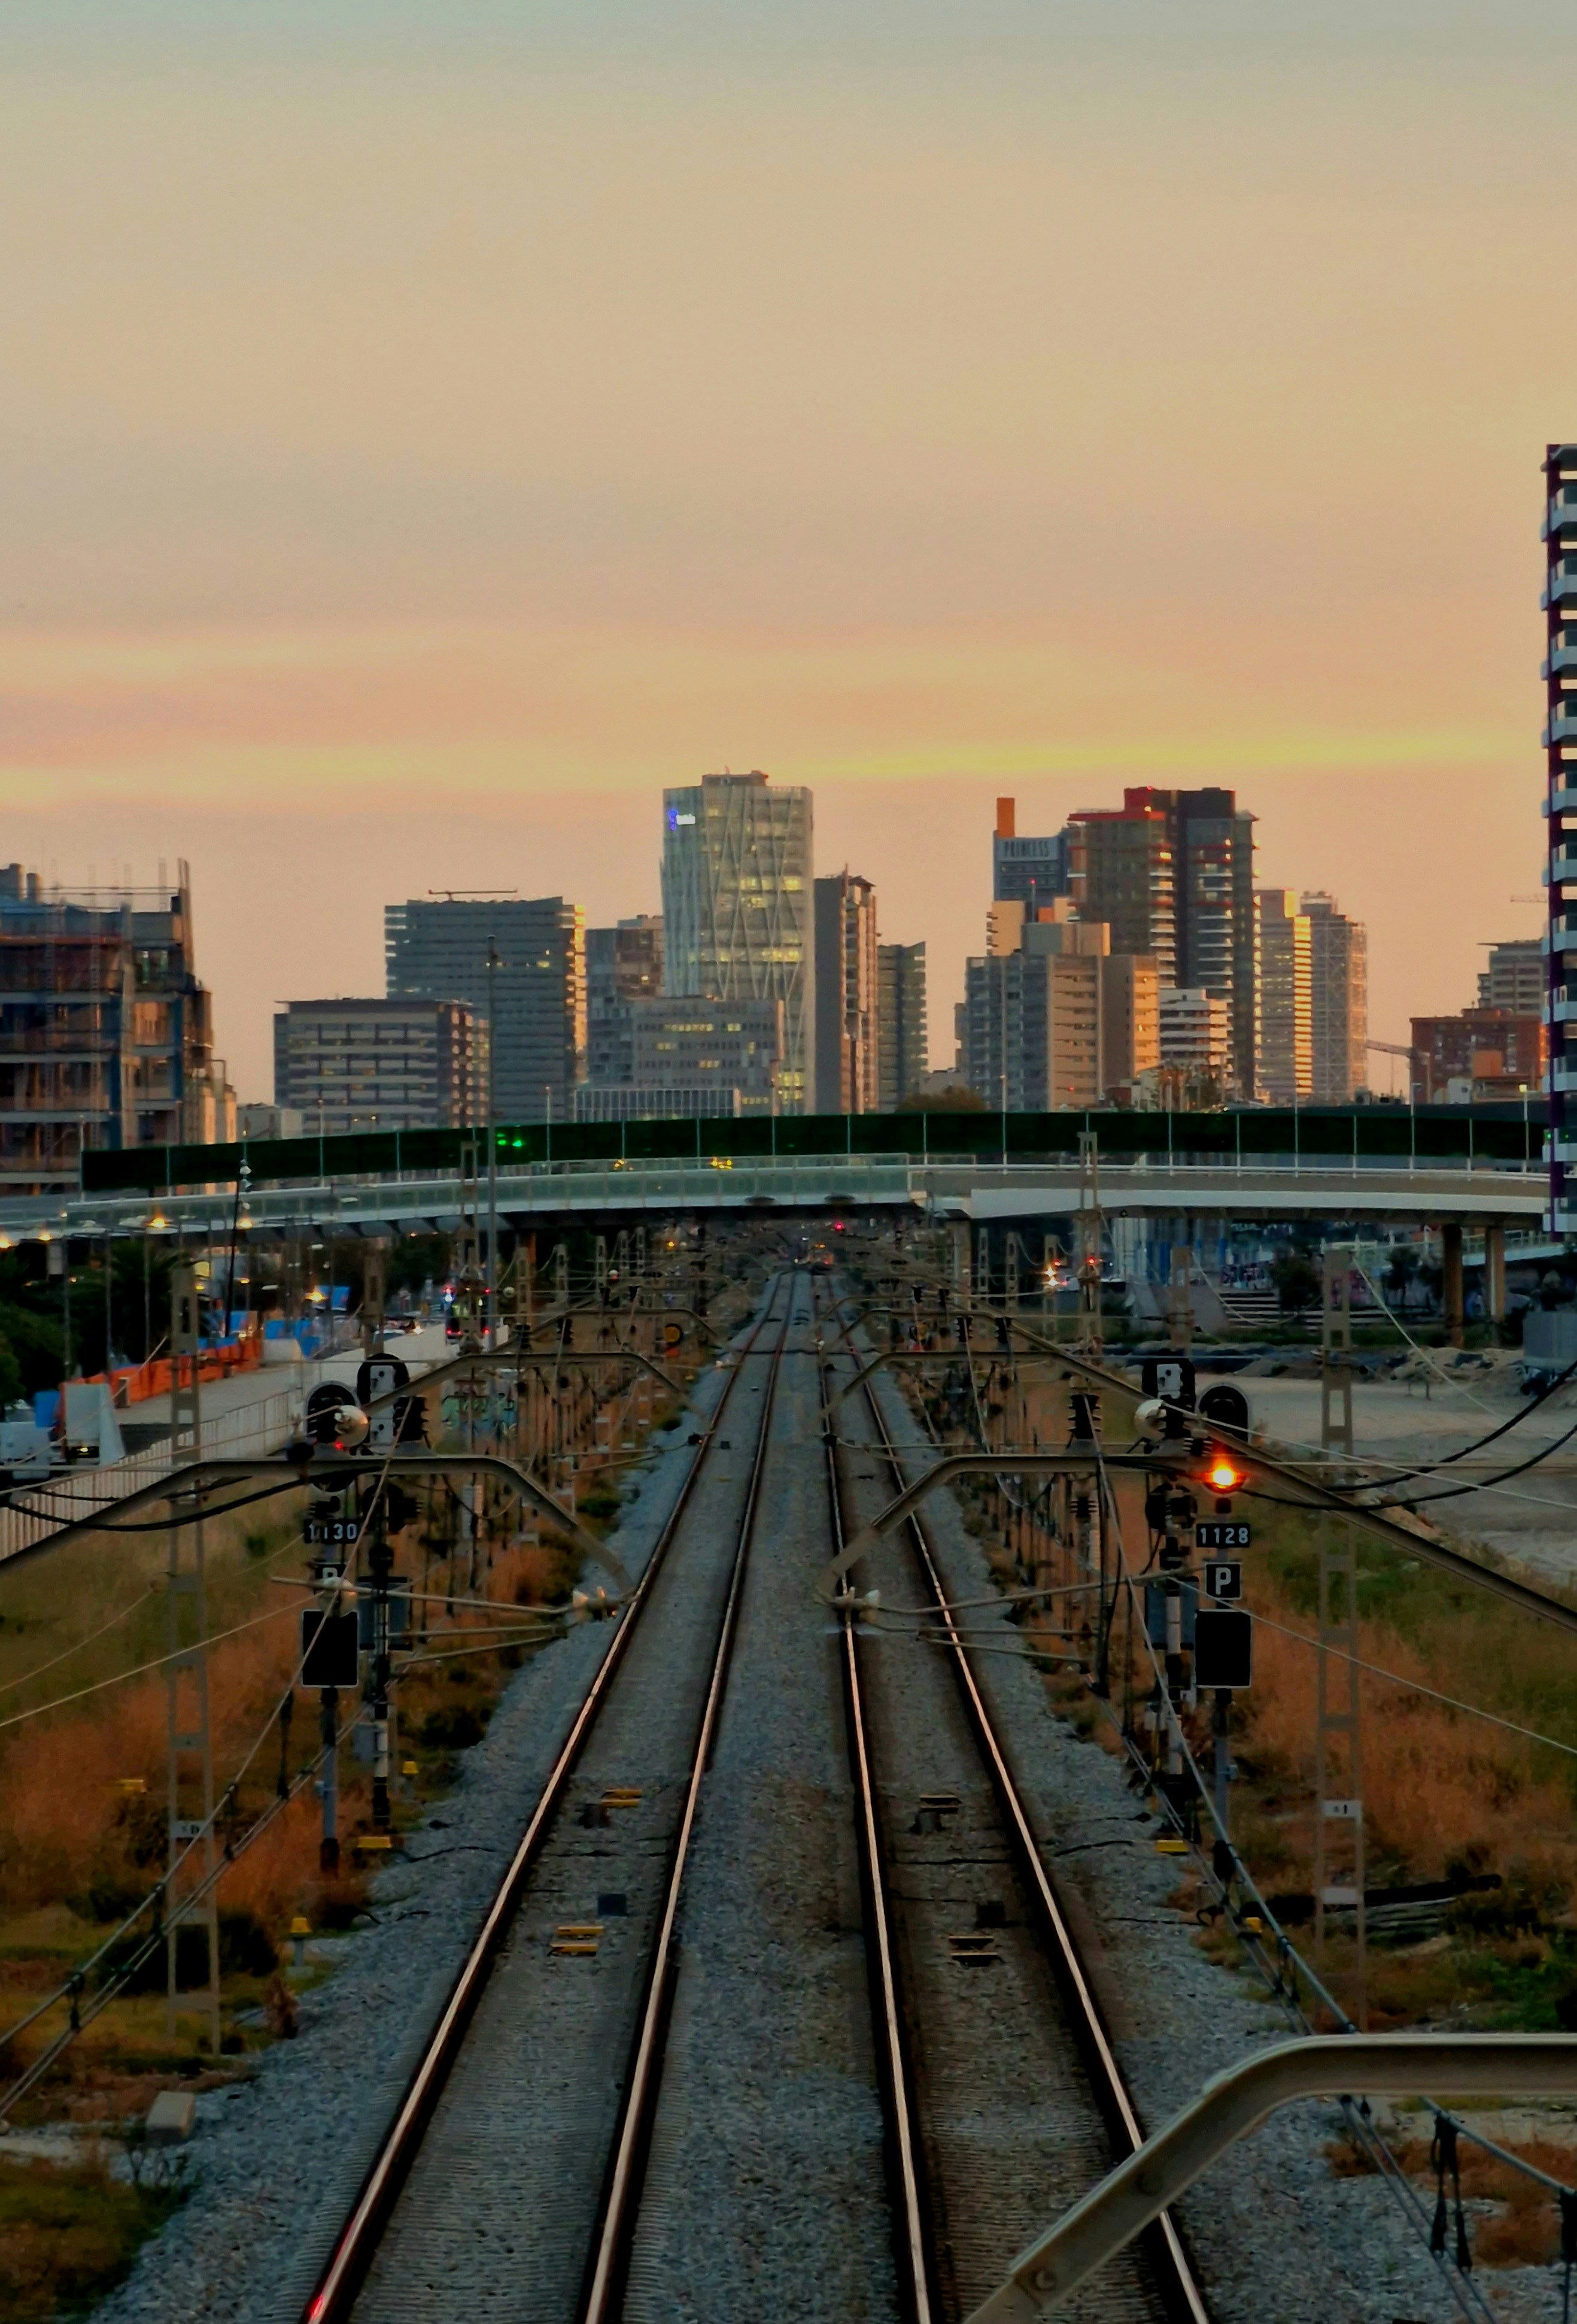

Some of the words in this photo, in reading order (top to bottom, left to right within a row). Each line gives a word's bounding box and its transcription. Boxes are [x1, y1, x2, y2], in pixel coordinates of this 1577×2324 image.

[1004, 840, 1050, 858] PRINCESS
[1200, 1527, 1248, 1544] 1128
[1216, 1567, 1231, 1595] P
